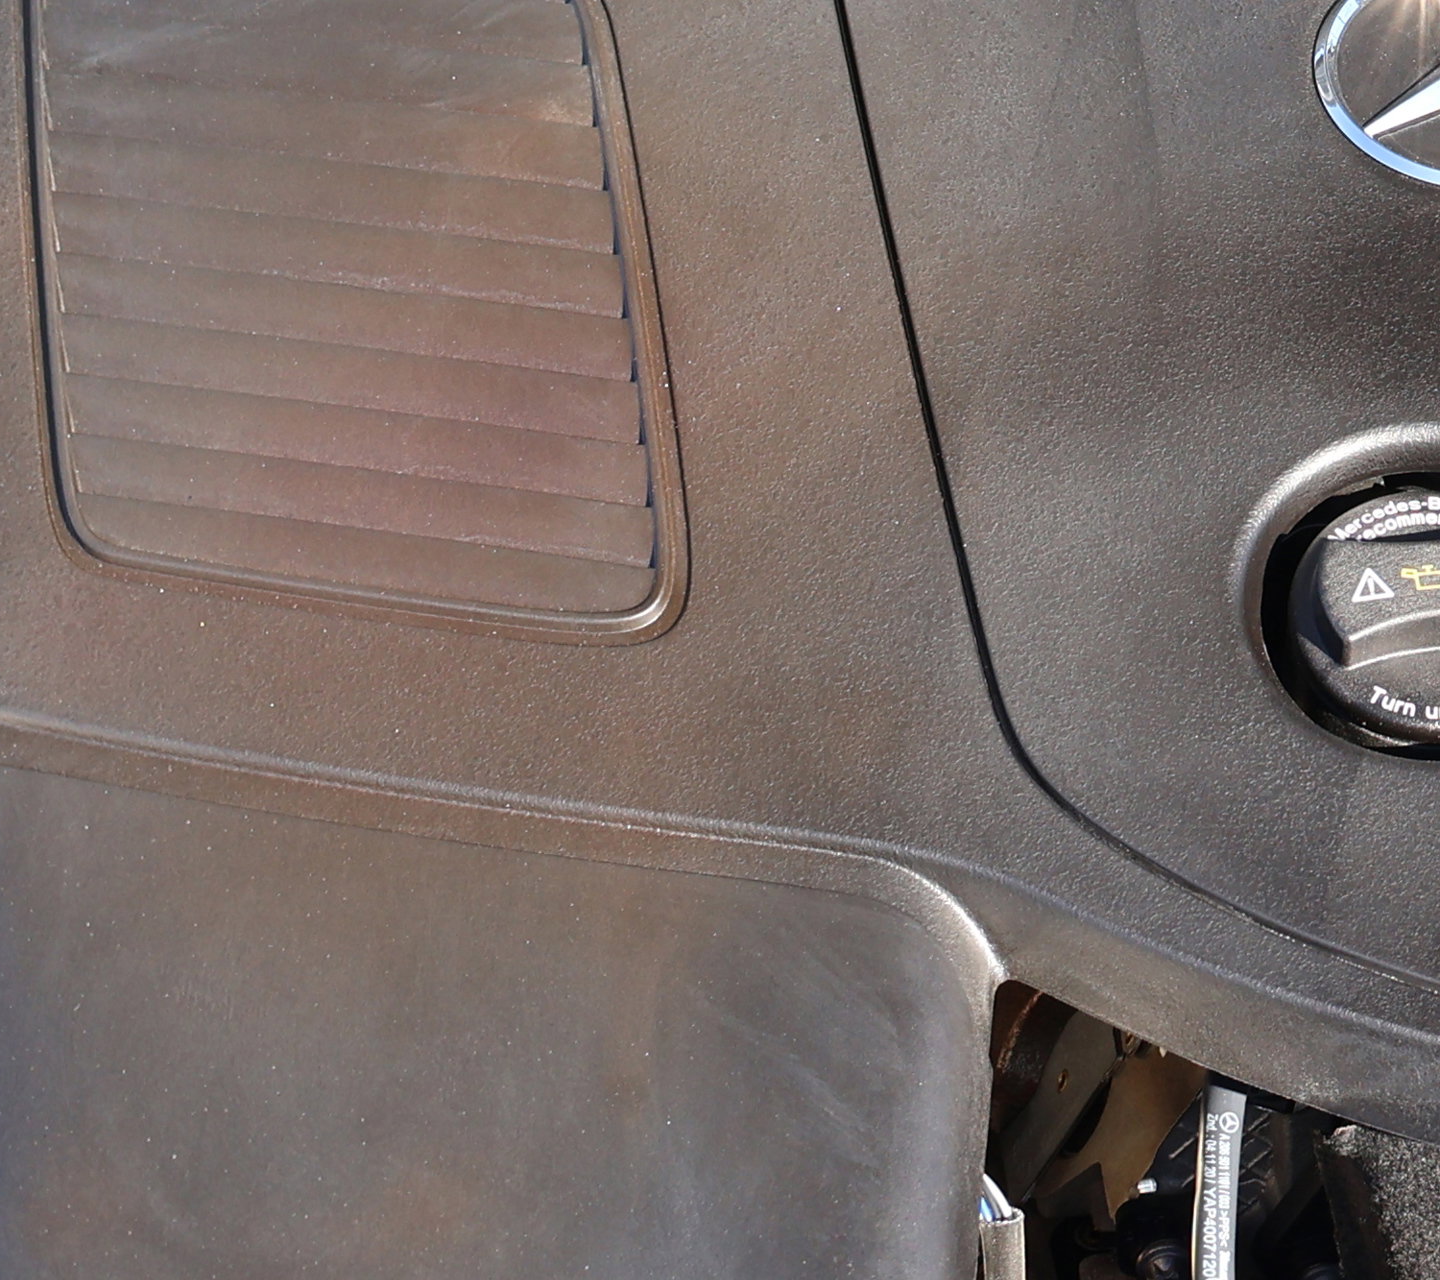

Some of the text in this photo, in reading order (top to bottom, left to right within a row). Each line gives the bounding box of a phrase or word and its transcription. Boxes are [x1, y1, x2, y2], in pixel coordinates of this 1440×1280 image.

[1371, 685, 1416, 718] Turn
[1203, 1187, 1218, 1278] YAP4007120
[1218, 1210, 1231, 1247] >PPS<
